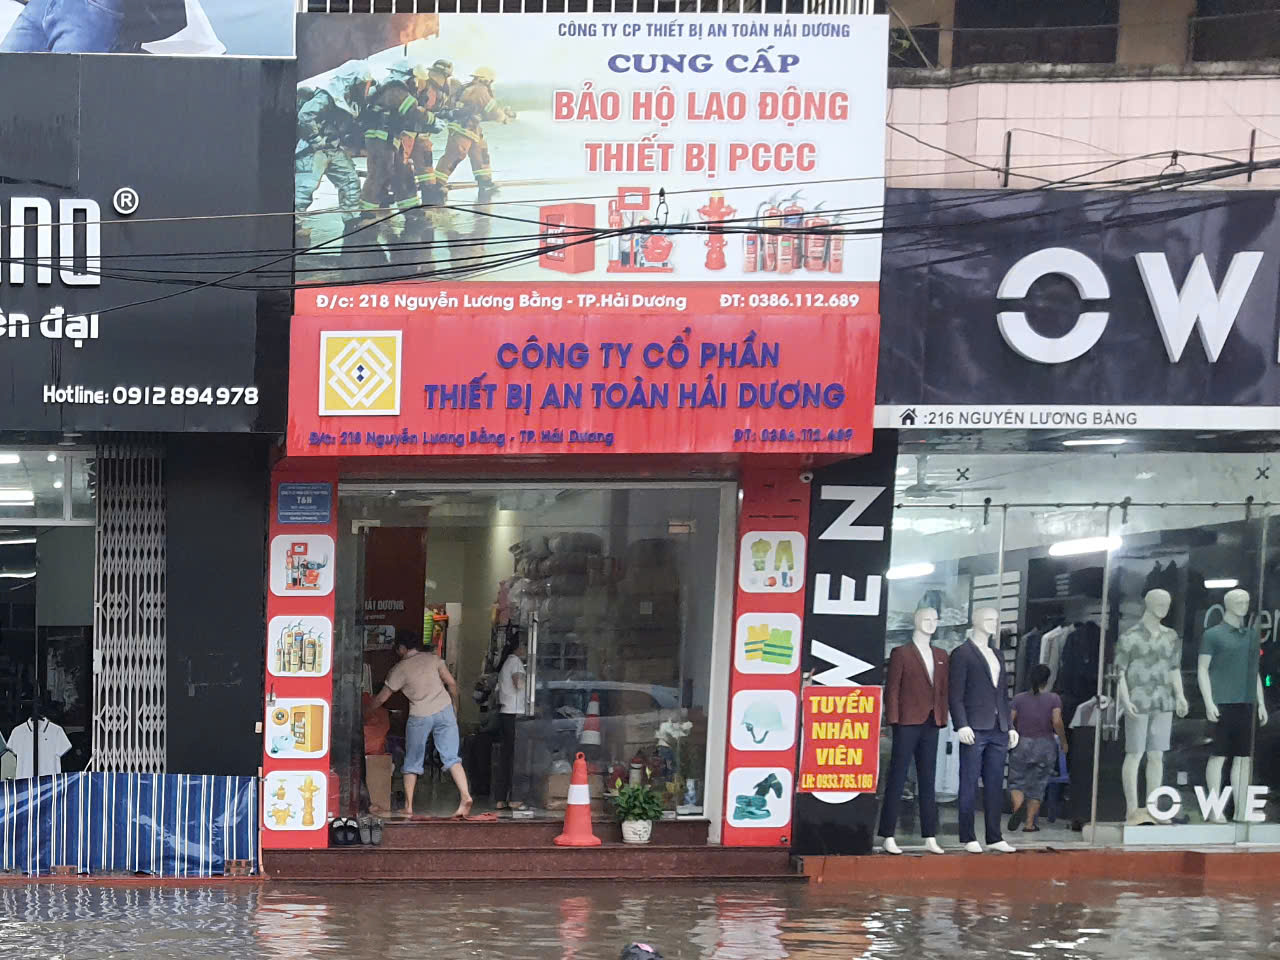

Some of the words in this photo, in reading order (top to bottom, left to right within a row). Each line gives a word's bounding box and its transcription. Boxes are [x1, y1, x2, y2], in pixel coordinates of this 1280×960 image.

[558, 20, 597, 37] CÔNG
[602, 23, 617, 37] TY
[622, 23, 641, 37] CP
[646, 19, 684, 37] THIẾT
[689, 23, 702, 40] BỊ
[707, 23, 727, 37] AN
[732, 20, 768, 37] TOÀN
[774, 19, 797, 37] HẢI
[802, 22, 850, 38] DƯƠNG
[608, 54, 714, 73] CUNG
[725, 45, 800, 73] CẤP
[554, 82, 620, 121] BẢO
[631, 85, 676, 127] HỘ
[687, 91, 747, 121] LAO
[758, 86, 849, 127] ĐỘNG
[585, 133, 675, 172] THIẾT
[684, 143, 717, 178] BỊ
[728, 143, 817, 172] PCCC
[316, 294, 354, 309] Đ/c:
[359, 294, 390, 308] 218
[394, 292, 459, 309] Nguyễn
[463, 294, 514, 310] Lương
[519, 292, 563, 310] Bằng
[577, 292, 629, 308] TP.Hải
[632, 294, 687, 310] Dương
[720, 294, 745, 308] ĐT:
[748, 293, 860, 308] 0386.112.689
[996, 247, 1280, 364] OW
[39, 305, 99, 348] đại
[496, 335, 589, 369] CÔNG
[600, 343, 632, 368] TY
[641, 326, 691, 369] CỔ
[699, 329, 779, 368] PHẦN
[43, 385, 109, 404] Hotline:
[113, 387, 166, 404] 0912
[171, 387, 213, 405] 894
[216, 388, 259, 405] 978
[423, 372, 498, 409] THIẾT
[506, 383, 533, 415] BỊ
[541, 383, 583, 408] AN
[591, 375, 670, 409] TOÀN
[678, 374, 729, 409] HẢI
[738, 379, 847, 409] DƯƠNG
[1029, 411, 1088, 425] LƯƠNG
[809, 689, 875, 714] TUYỂN
[812, 719, 870, 740] NHÂN
[816, 744, 863, 766] VIÊN
